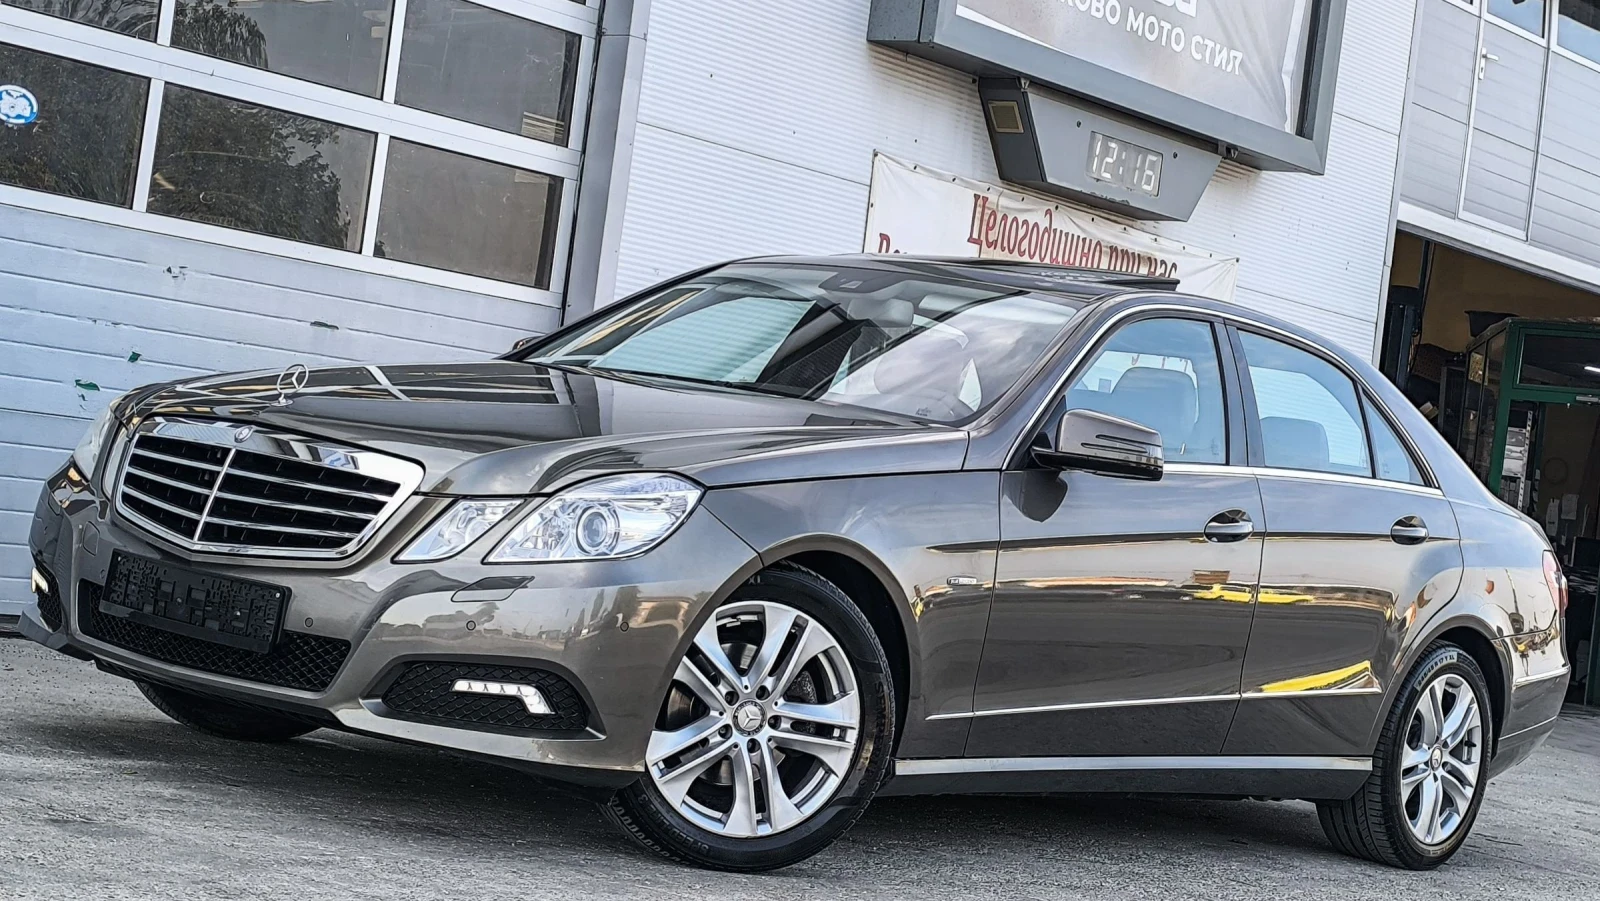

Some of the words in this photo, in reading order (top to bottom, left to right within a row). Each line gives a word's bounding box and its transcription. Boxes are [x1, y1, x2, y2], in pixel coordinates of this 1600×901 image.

[1059, 0, 1121, 25] ВО
[1126, 6, 1185, 53] МОТО
[1190, 35, 1243, 76] СТИЛ
[1092, 138, 1158, 191] 12:16
[967, 193, 1103, 269] Целогодишно
